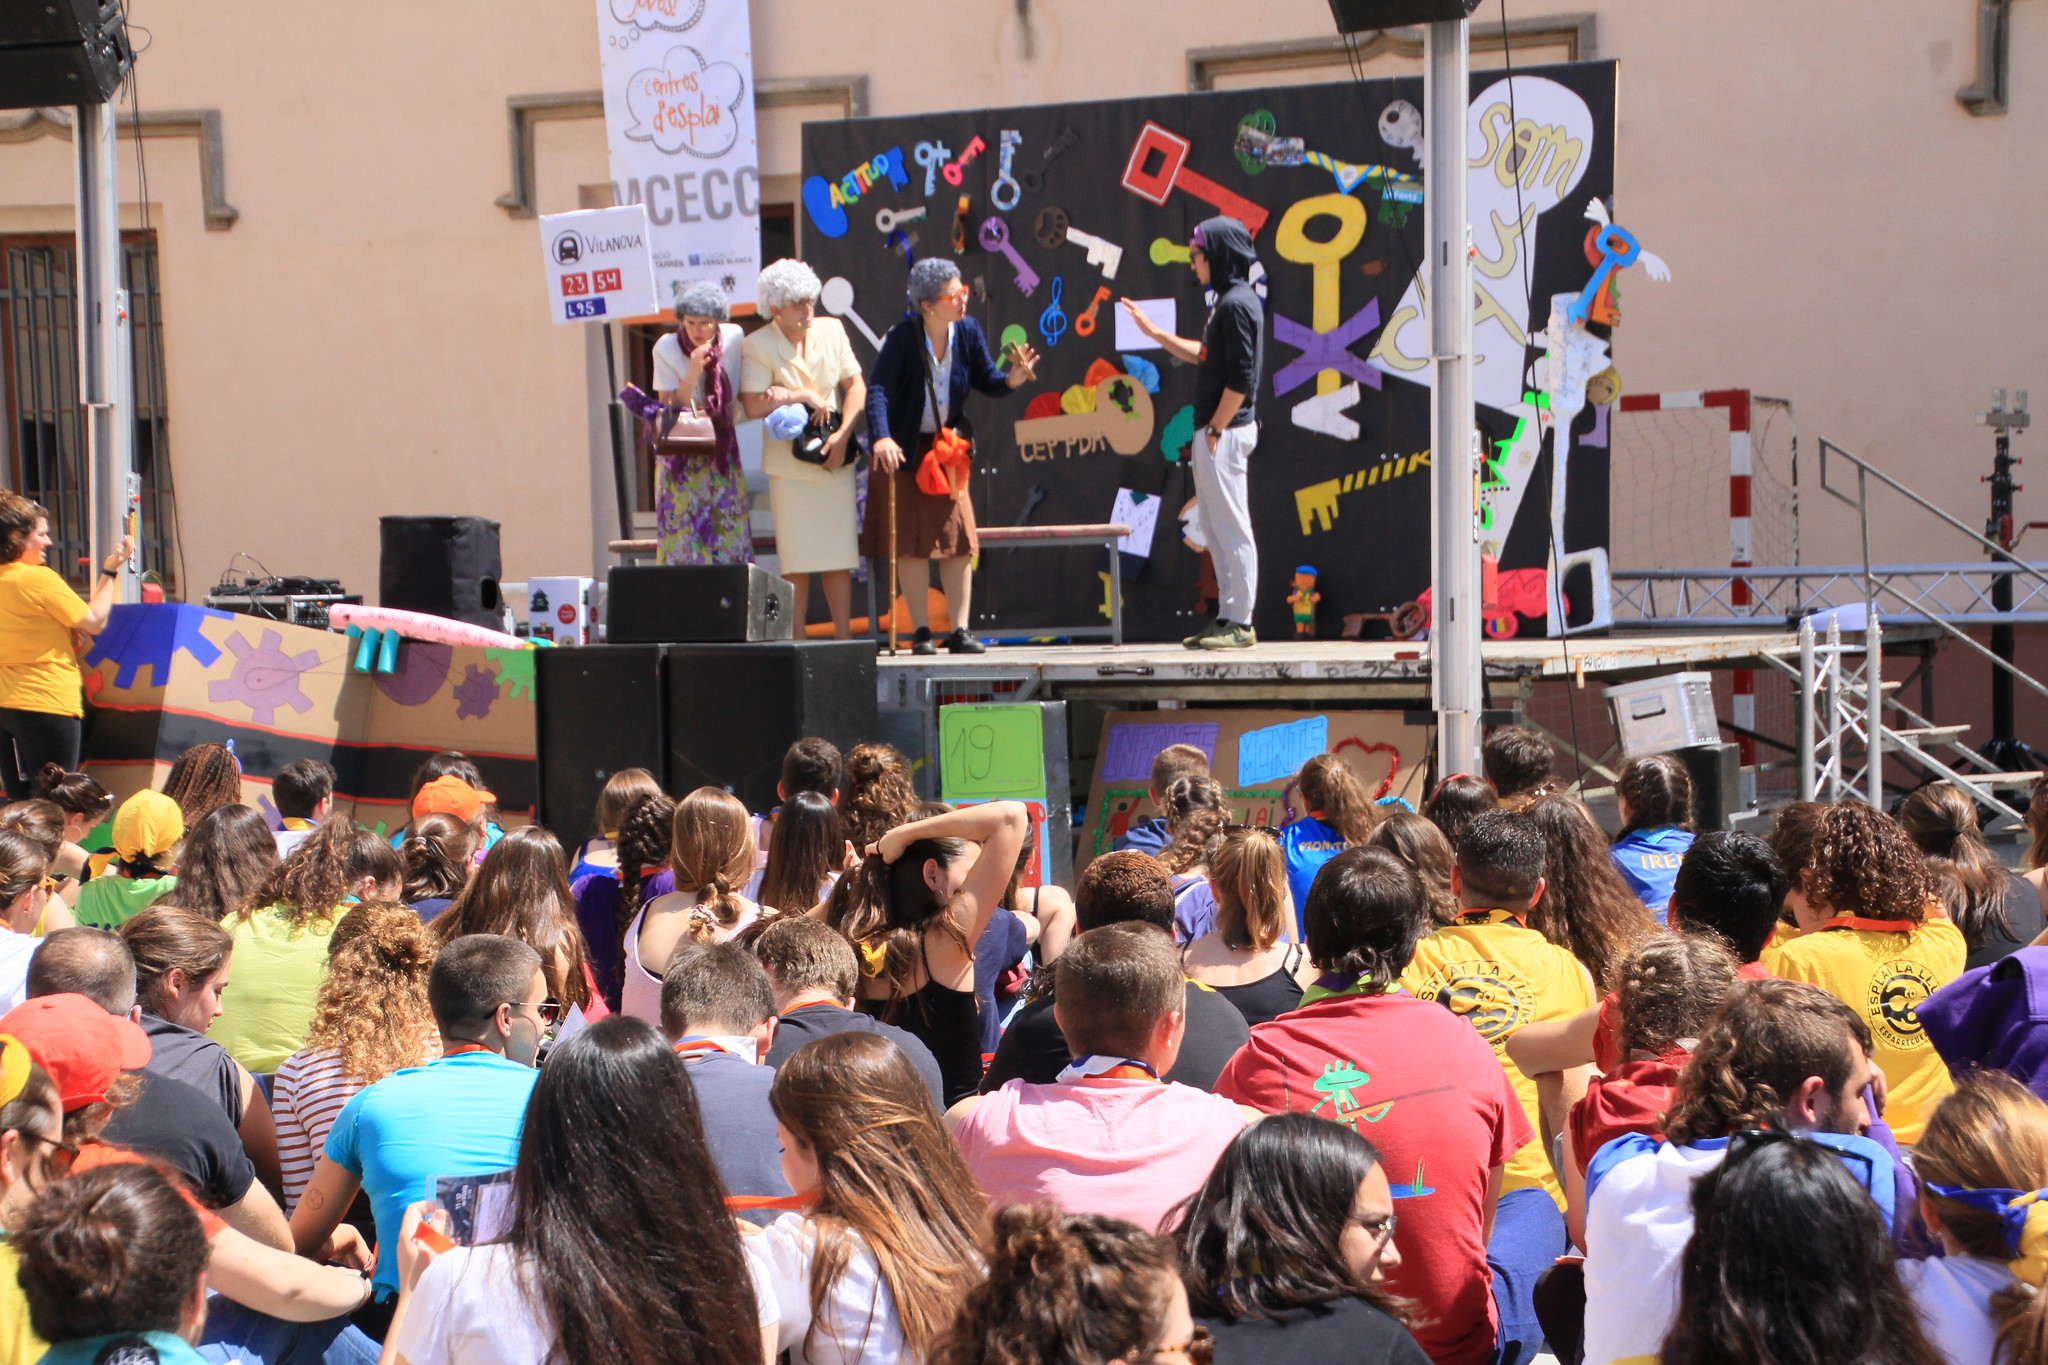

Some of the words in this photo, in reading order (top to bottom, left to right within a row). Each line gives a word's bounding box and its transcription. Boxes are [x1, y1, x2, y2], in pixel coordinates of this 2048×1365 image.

[644, 70, 699, 96] centres
[652, 92, 720, 145] d'esplai
[829, 153, 890, 210] ACTITUD
[565, 276, 585, 294] 23
[597, 271, 617, 289] 54
[1020, 437, 1060, 462] CEP
[951, 724, 994, 785] 19
[1895, 962, 1914, 974] LA
